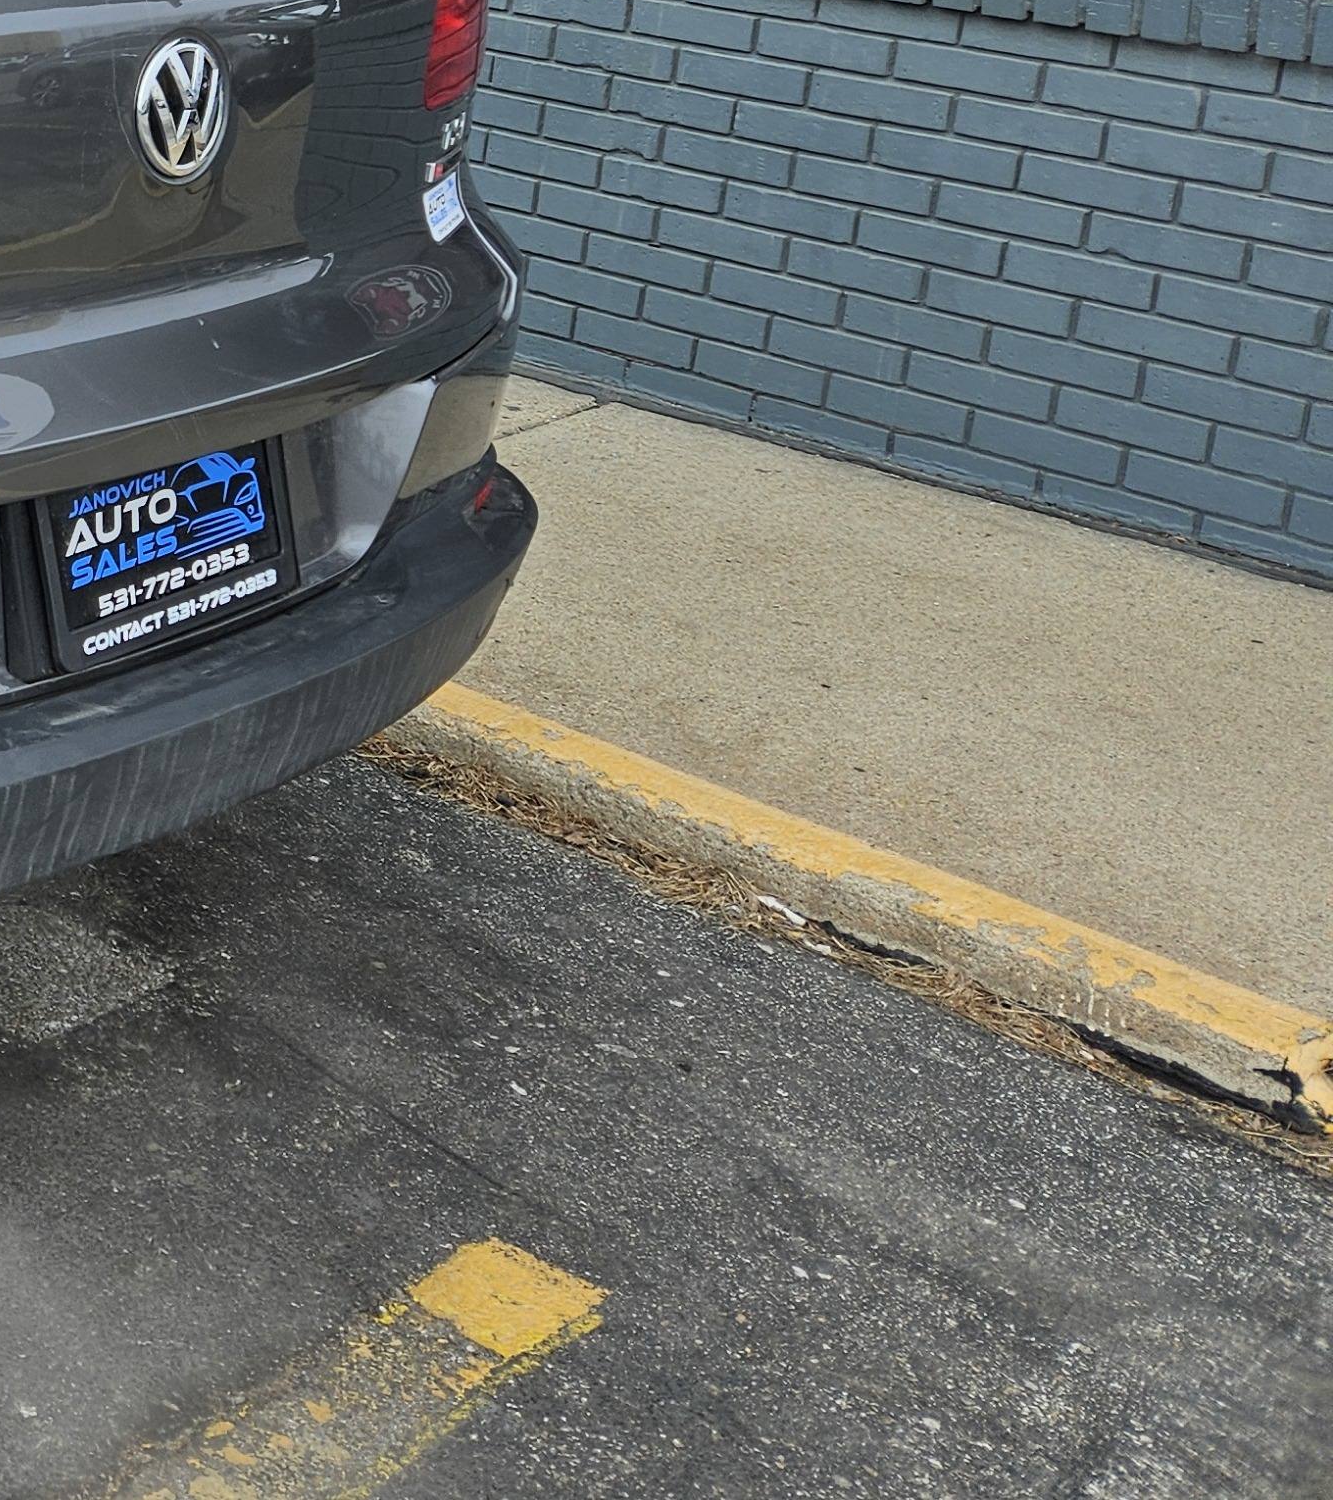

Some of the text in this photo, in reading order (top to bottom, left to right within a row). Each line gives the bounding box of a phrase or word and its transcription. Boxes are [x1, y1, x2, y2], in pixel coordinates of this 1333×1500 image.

[65, 488, 178, 558] AUTO
[68, 470, 167, 519] JANOVICH
[70, 524, 178, 590] SALES
[98, 542, 251, 618] 531-772-0353
[83, 568, 278, 656] CONTACT 531-772-0353
